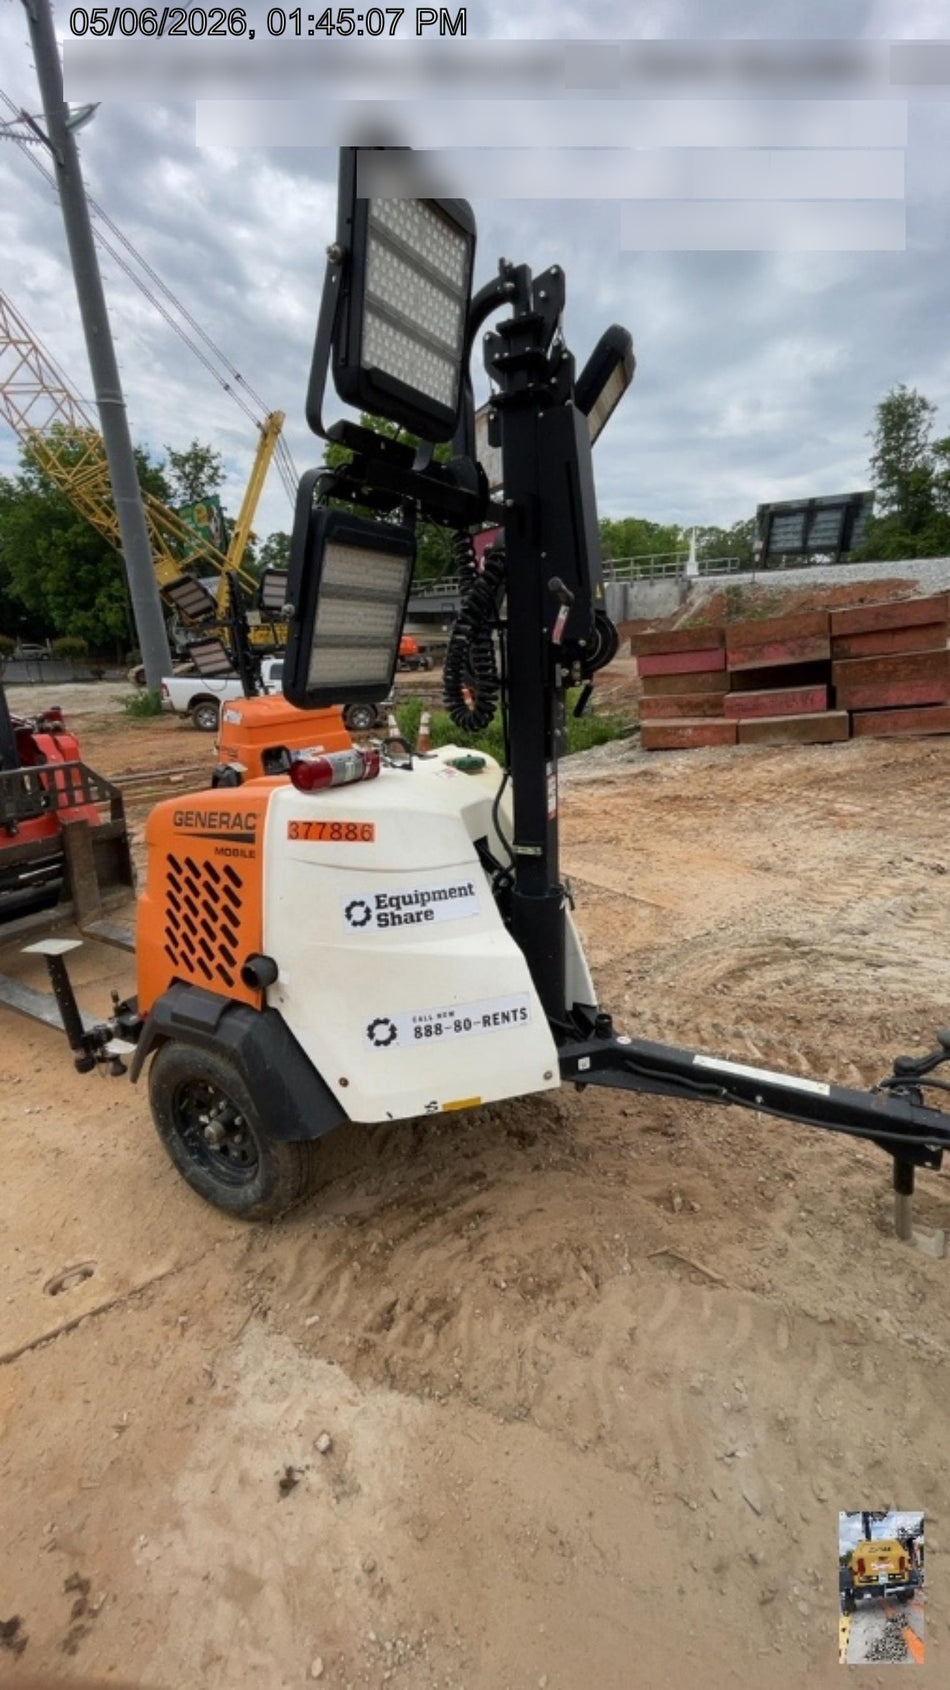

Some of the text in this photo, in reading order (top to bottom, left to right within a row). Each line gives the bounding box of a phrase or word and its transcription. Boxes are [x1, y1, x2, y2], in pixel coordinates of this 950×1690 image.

[173, 810, 257, 830] GENERAC
[288, 822, 375, 842] 377886
[214, 847, 255, 859] MOBILE
[374, 882, 475, 910] Equipment
[376, 908, 435, 928] Share
[413, 1007, 529, 1039] 888-80-RENTS
